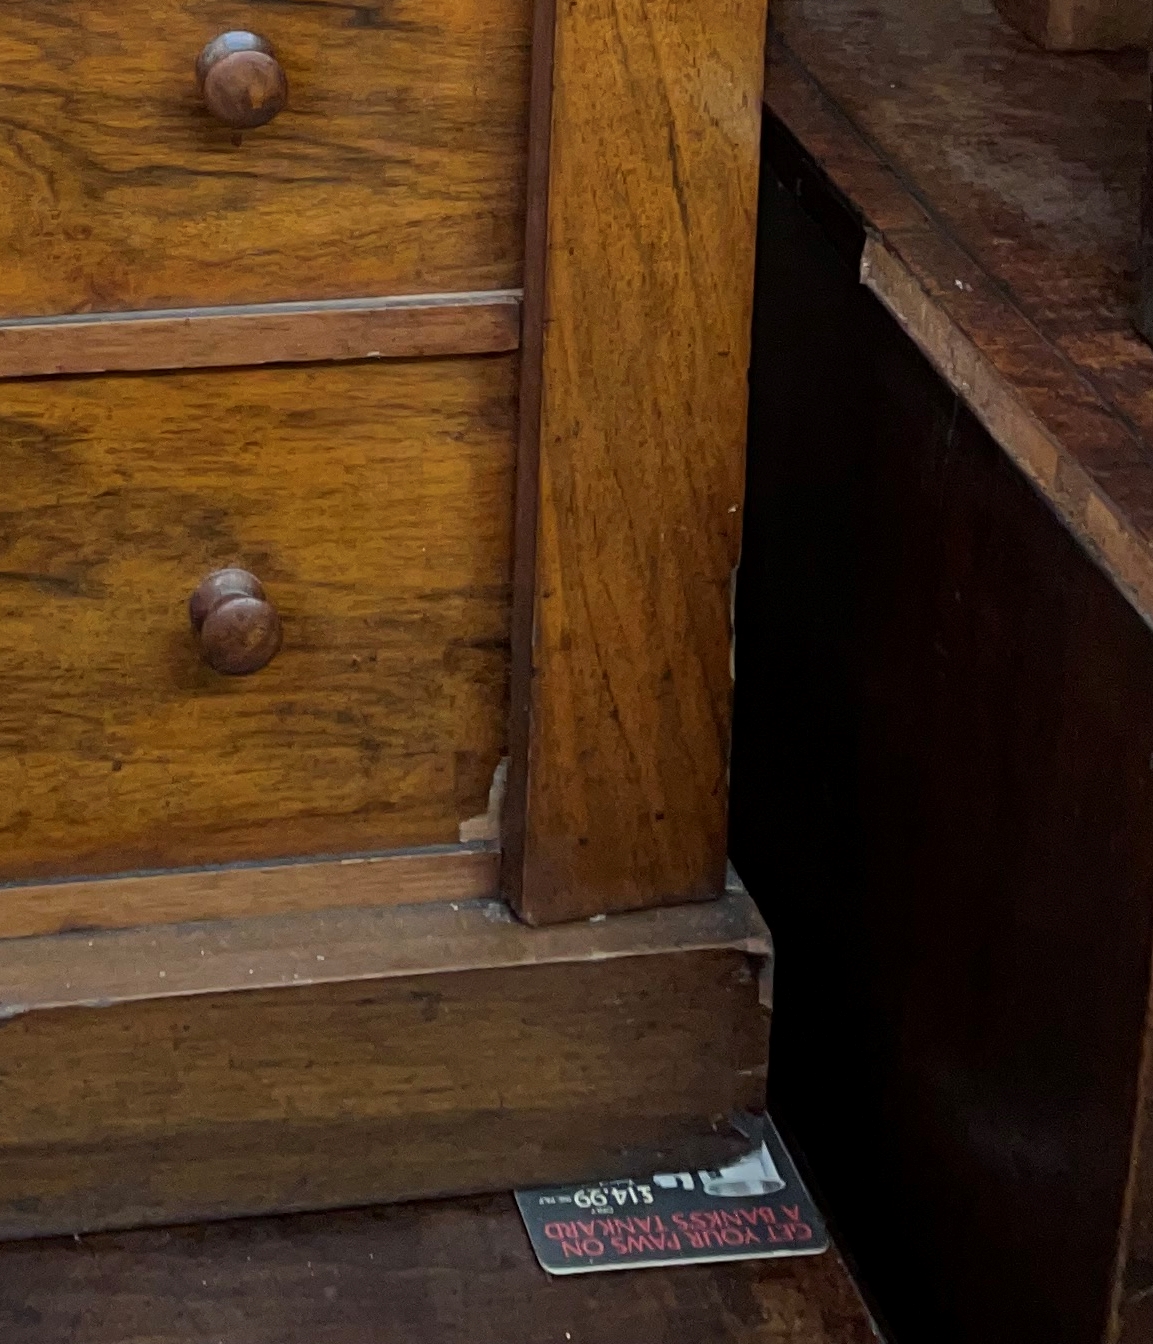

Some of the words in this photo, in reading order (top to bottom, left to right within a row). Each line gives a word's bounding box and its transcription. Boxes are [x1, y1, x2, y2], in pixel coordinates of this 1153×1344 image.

[574, 1184, 653, 1208] £14.99
[780, 1203, 799, 1221] A
[544, 1215, 667, 1240] TANKARD
[683, 1227, 760, 1248] YOUR
[767, 1223, 812, 1243] GET
[561, 1238, 604, 1258] ON
[611, 1232, 681, 1254] PAWS
